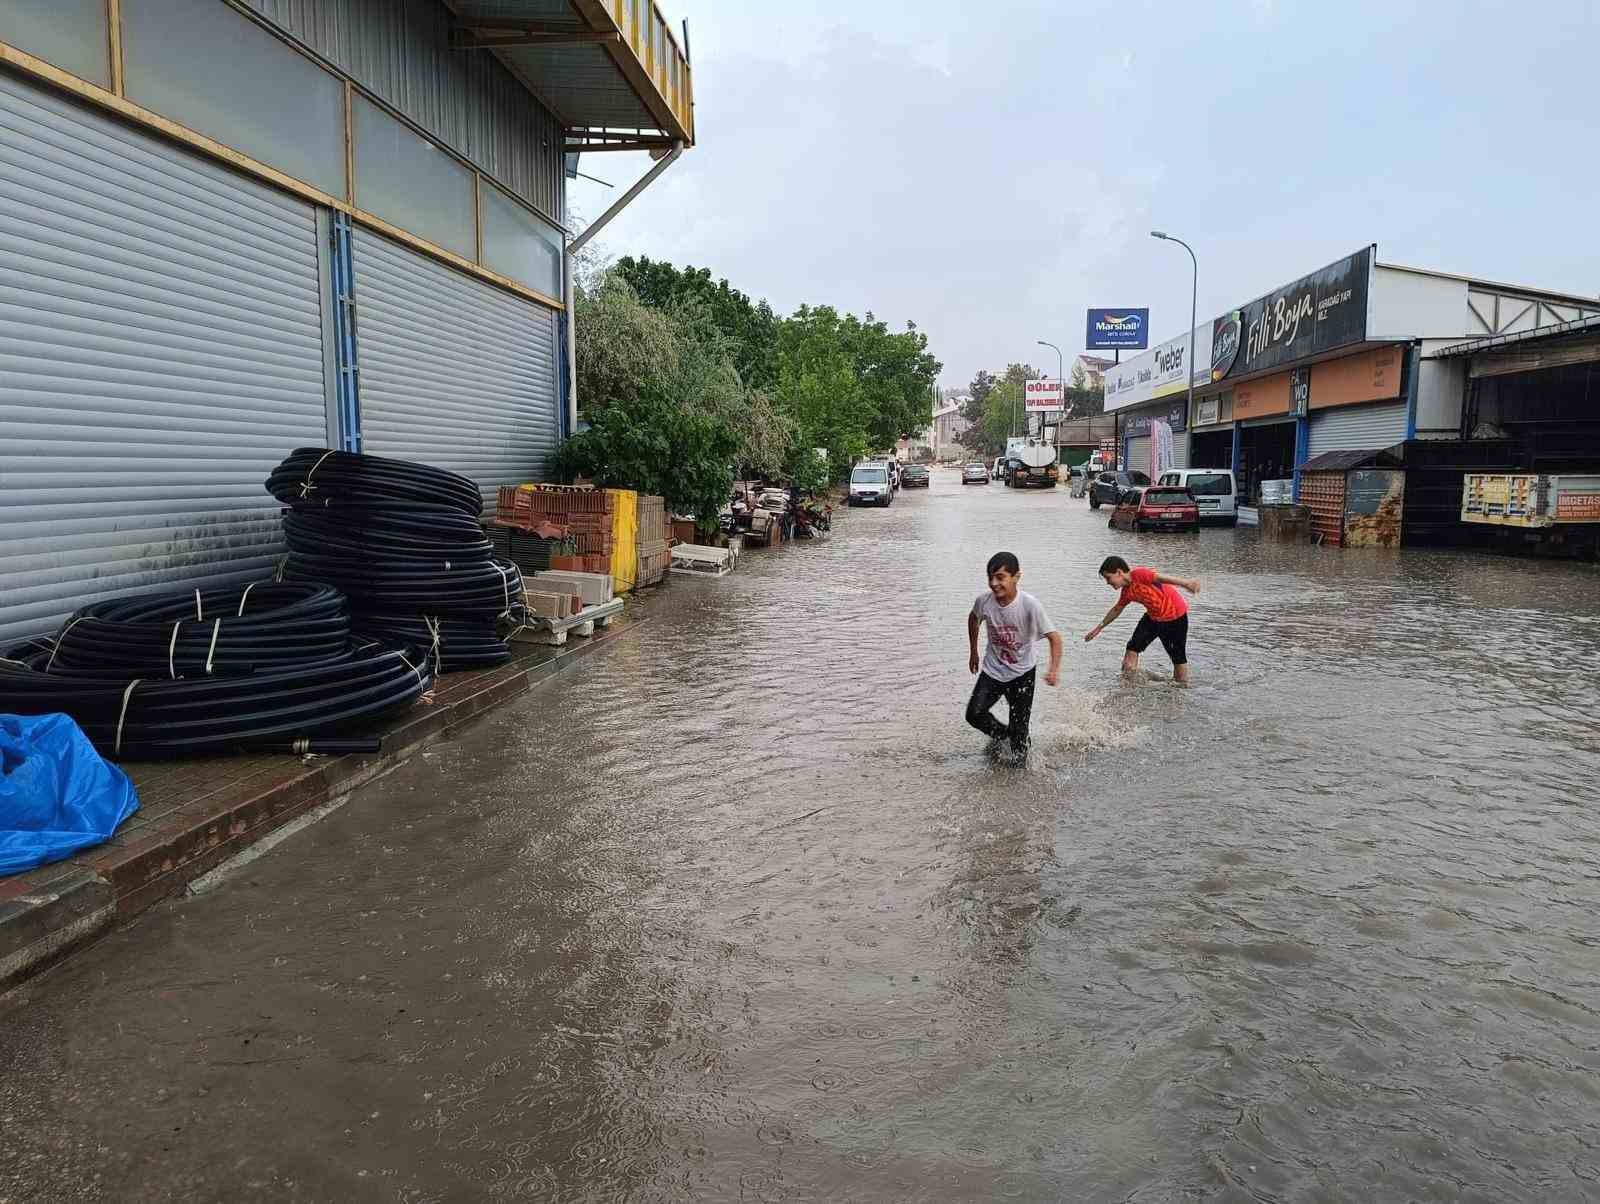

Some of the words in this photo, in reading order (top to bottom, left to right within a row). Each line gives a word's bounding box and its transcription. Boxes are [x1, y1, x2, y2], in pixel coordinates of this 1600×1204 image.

[1095, 321, 1137, 331] Marshall
[1246, 304, 1272, 365] Filli
[1273, 293, 1313, 346] Boya
[1160, 344, 1184, 373] weber
